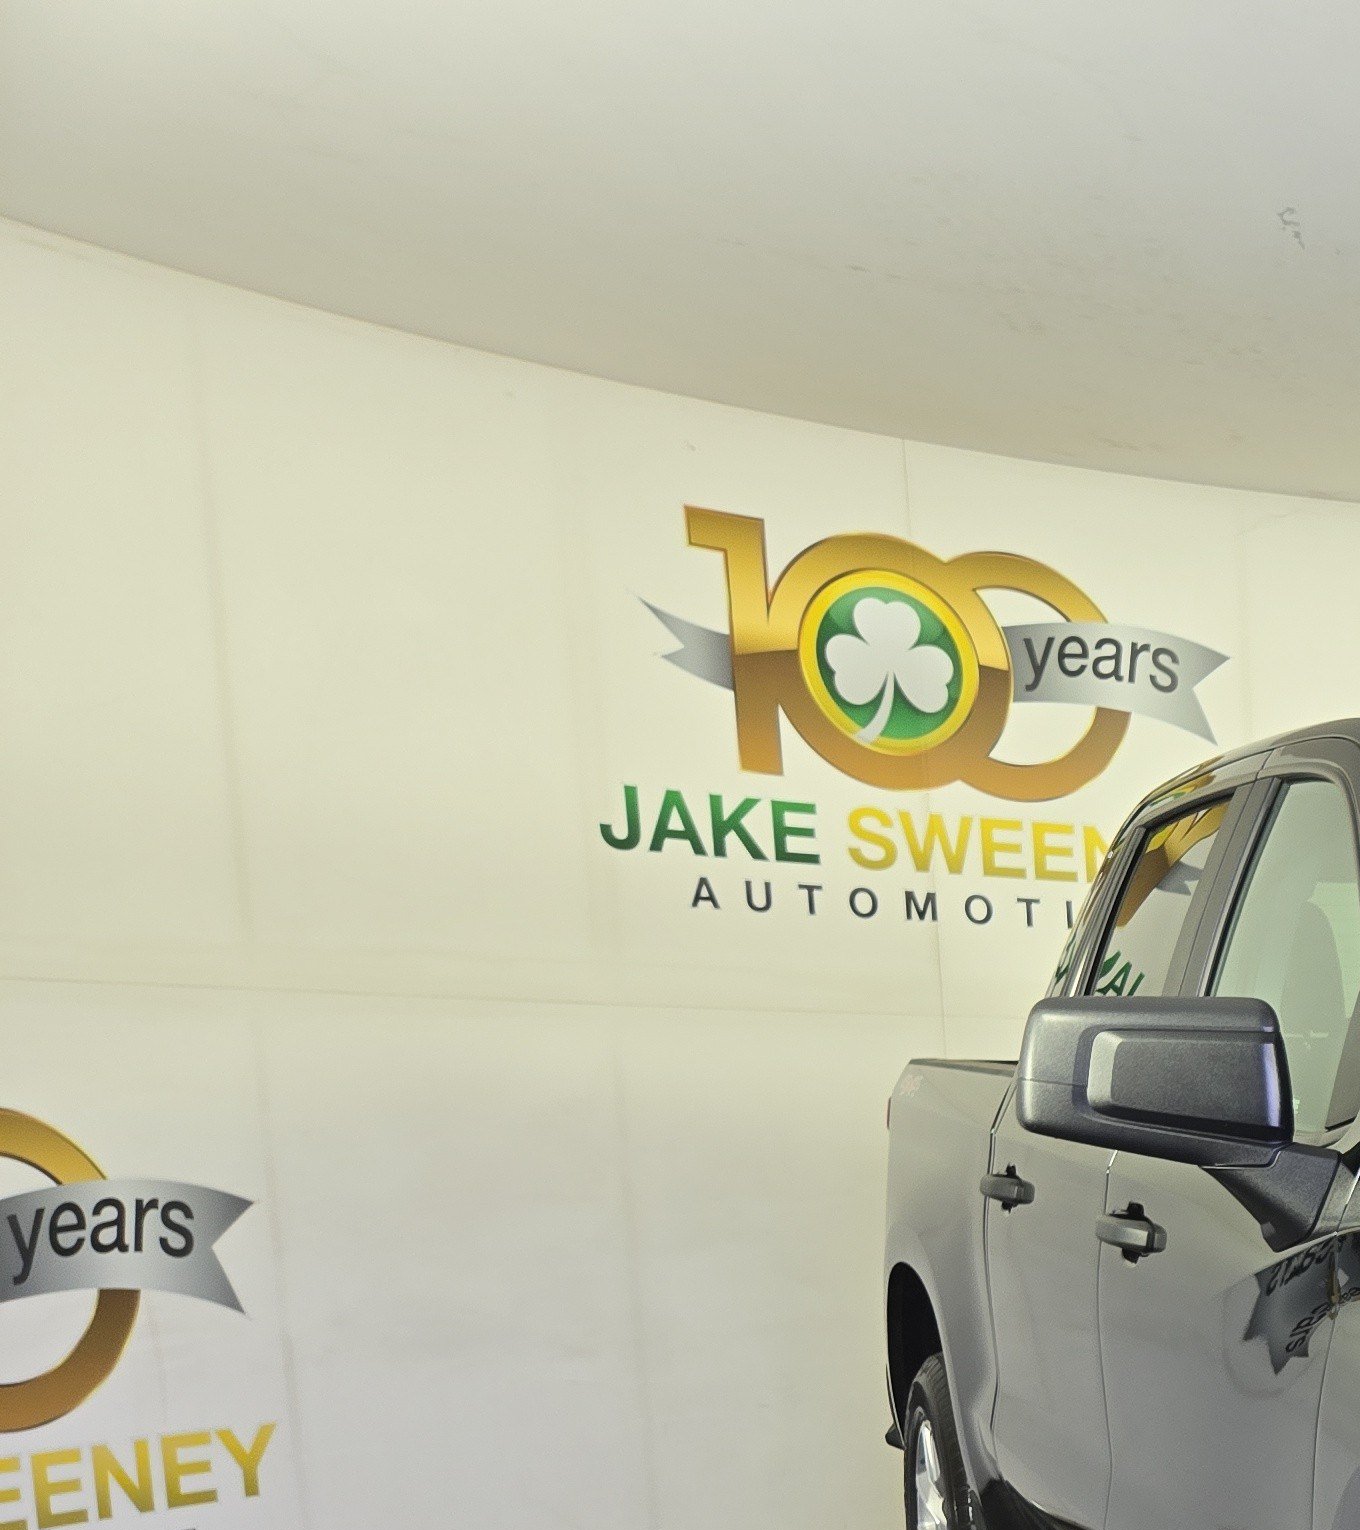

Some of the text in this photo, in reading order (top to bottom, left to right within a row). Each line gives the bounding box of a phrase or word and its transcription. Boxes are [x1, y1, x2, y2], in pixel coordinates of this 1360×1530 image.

[685, 504, 1180, 803] 100 years
[599, 784, 1115, 884] JAKE SWEE
[691, 876, 1074, 929] AUTOMOTI
[7, 1196, 195, 1287] years
